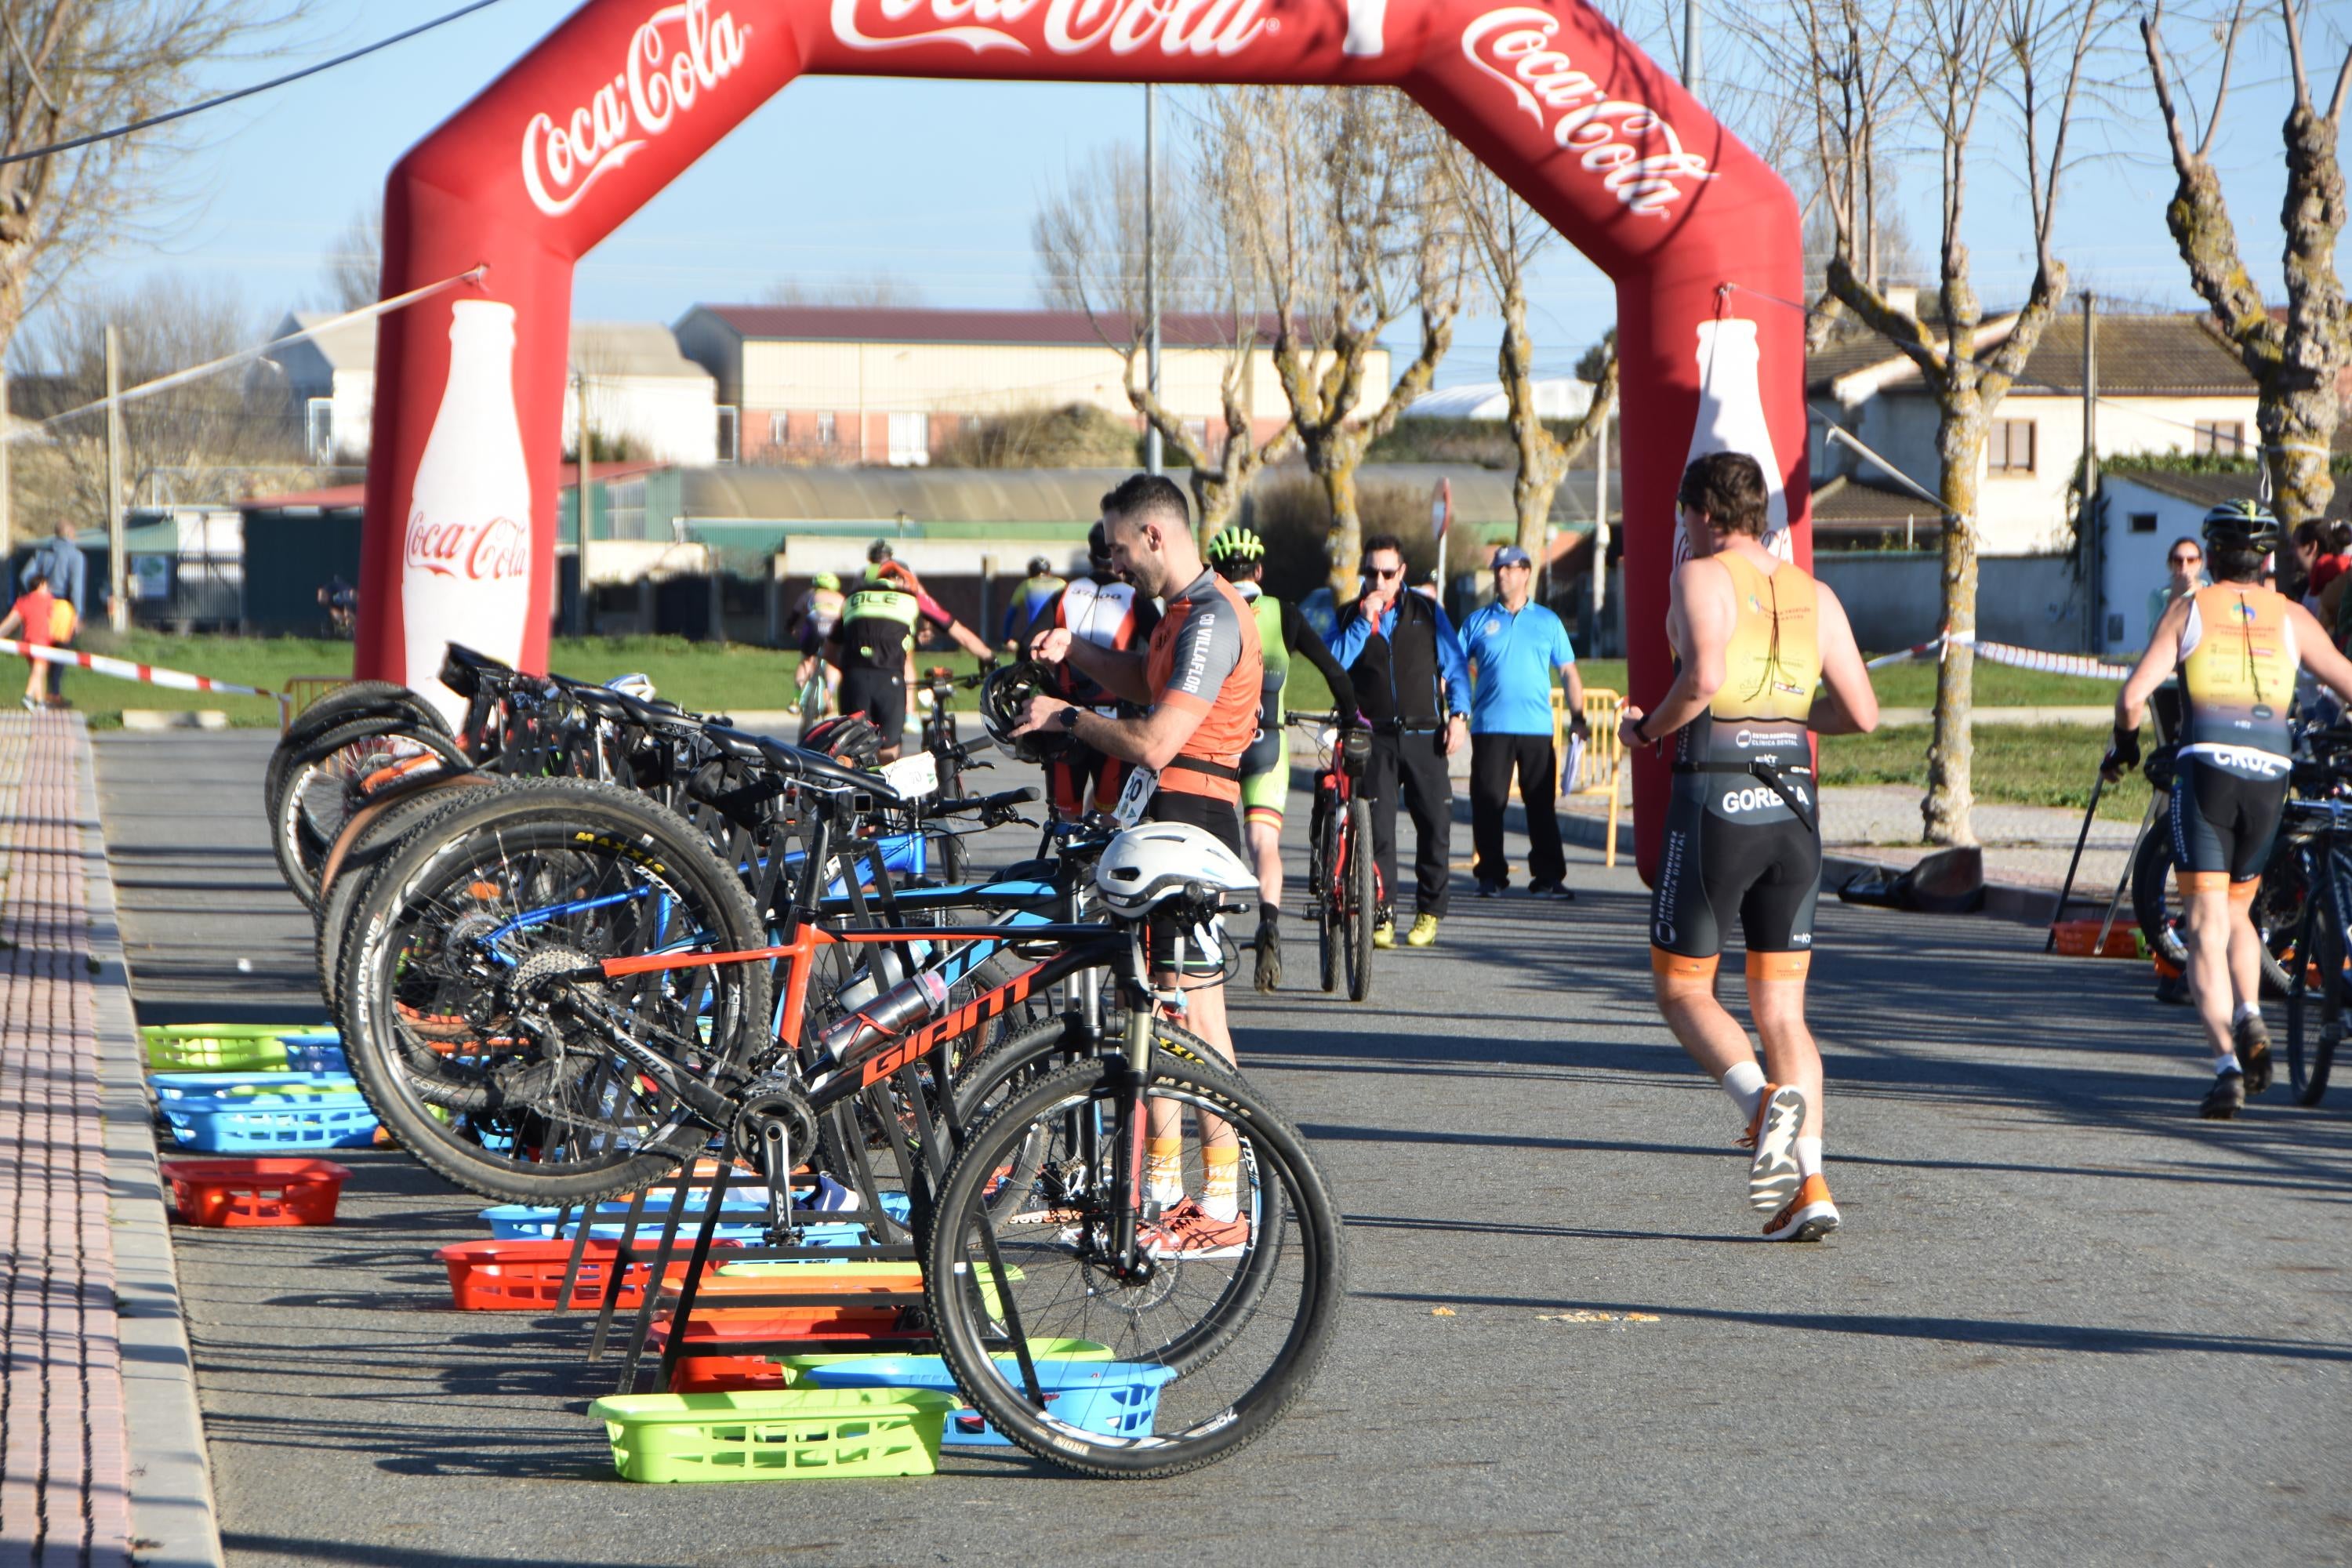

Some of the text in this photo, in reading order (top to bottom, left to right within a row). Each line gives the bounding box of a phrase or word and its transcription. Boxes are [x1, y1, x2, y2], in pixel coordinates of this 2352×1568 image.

[1181, 613, 1215, 694] CD VILLAFLOR
[1722, 786, 1810, 814] GORBA
[1672, 831, 1686, 877] DENTAL
[358, 916, 381, 1022] CHAOYANG
[862, 960, 1048, 1088] GIANT
[618, 1038, 673, 1074] GIANT
[1155, 1076, 1251, 1118] MAXXIS
[775, 1189, 786, 1228] SLX
